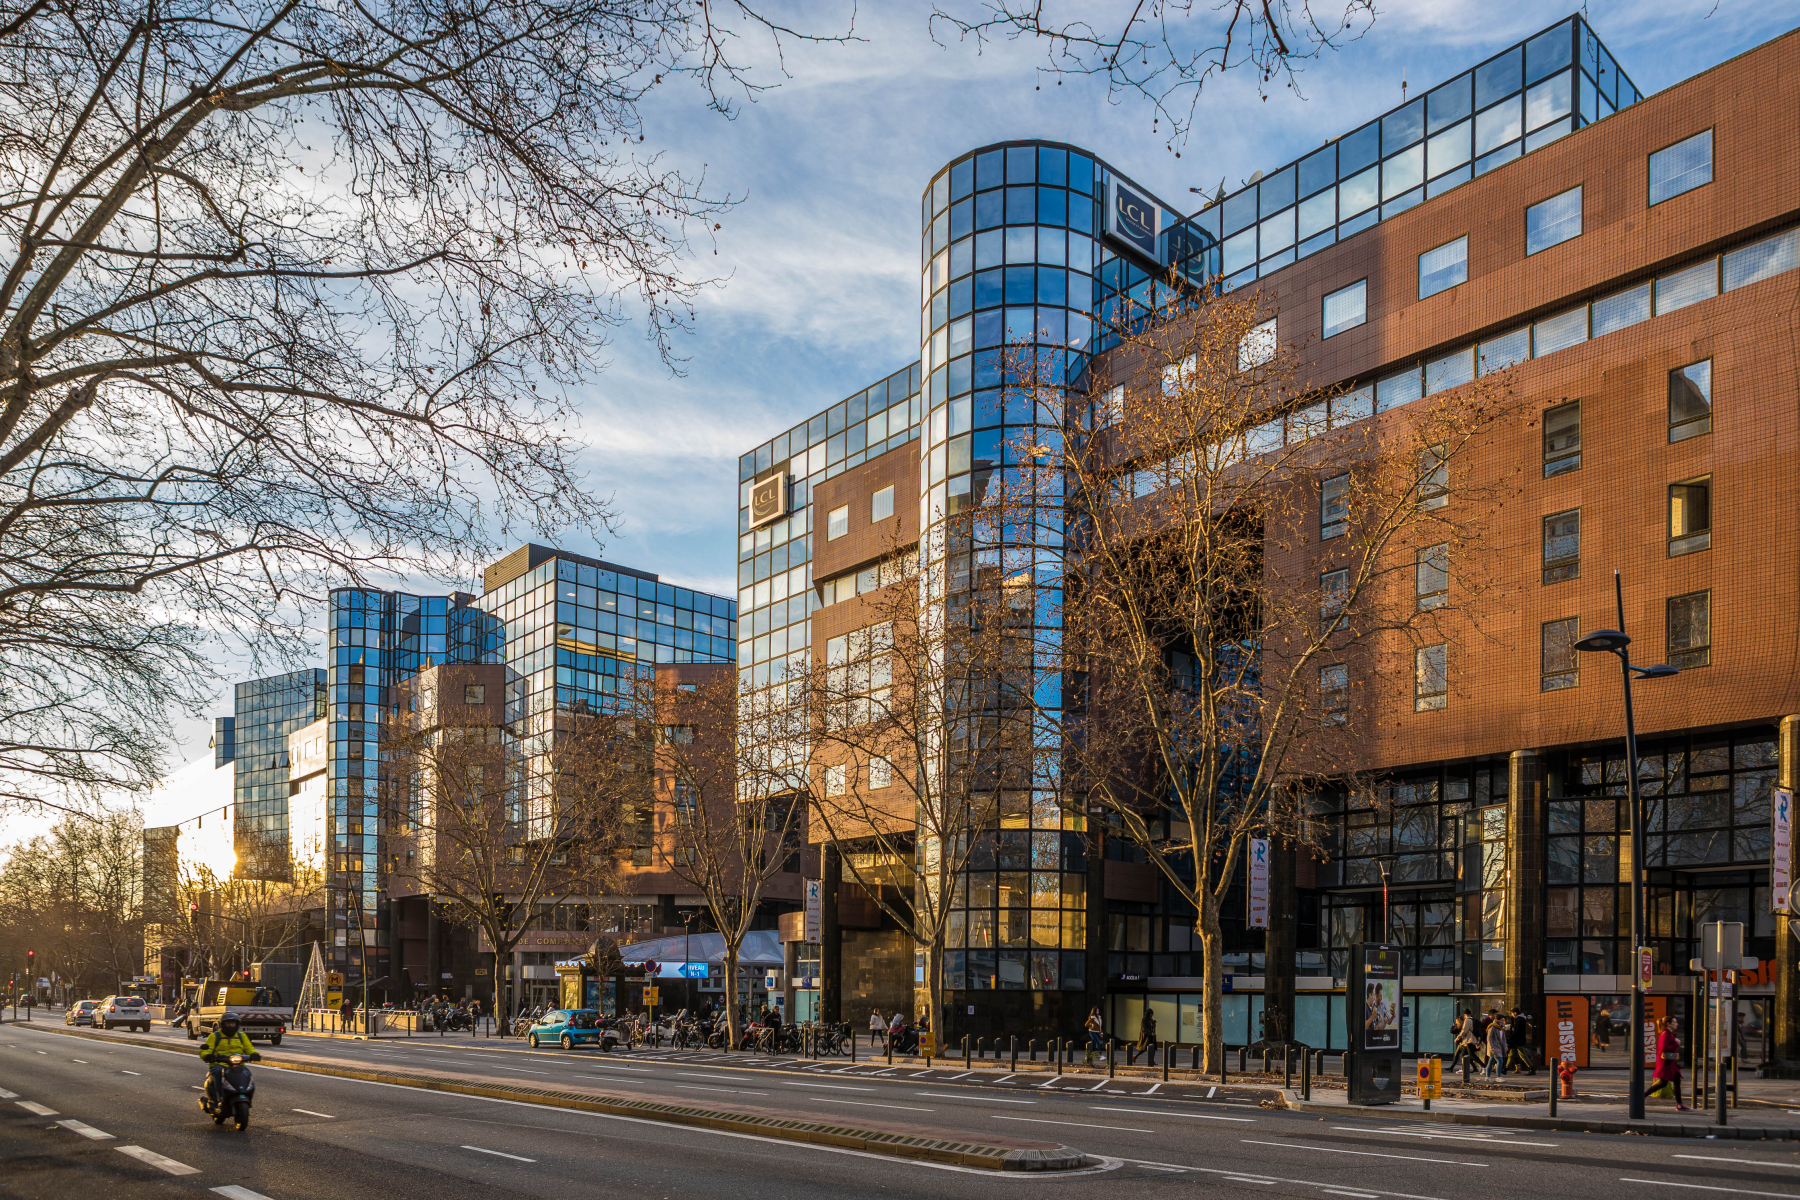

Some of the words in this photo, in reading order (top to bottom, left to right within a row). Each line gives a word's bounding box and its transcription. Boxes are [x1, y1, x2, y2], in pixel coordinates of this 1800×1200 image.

[1119, 196, 1150, 230] LCL
[754, 488, 776, 506] LCL
[518, 937, 529, 945] DE
